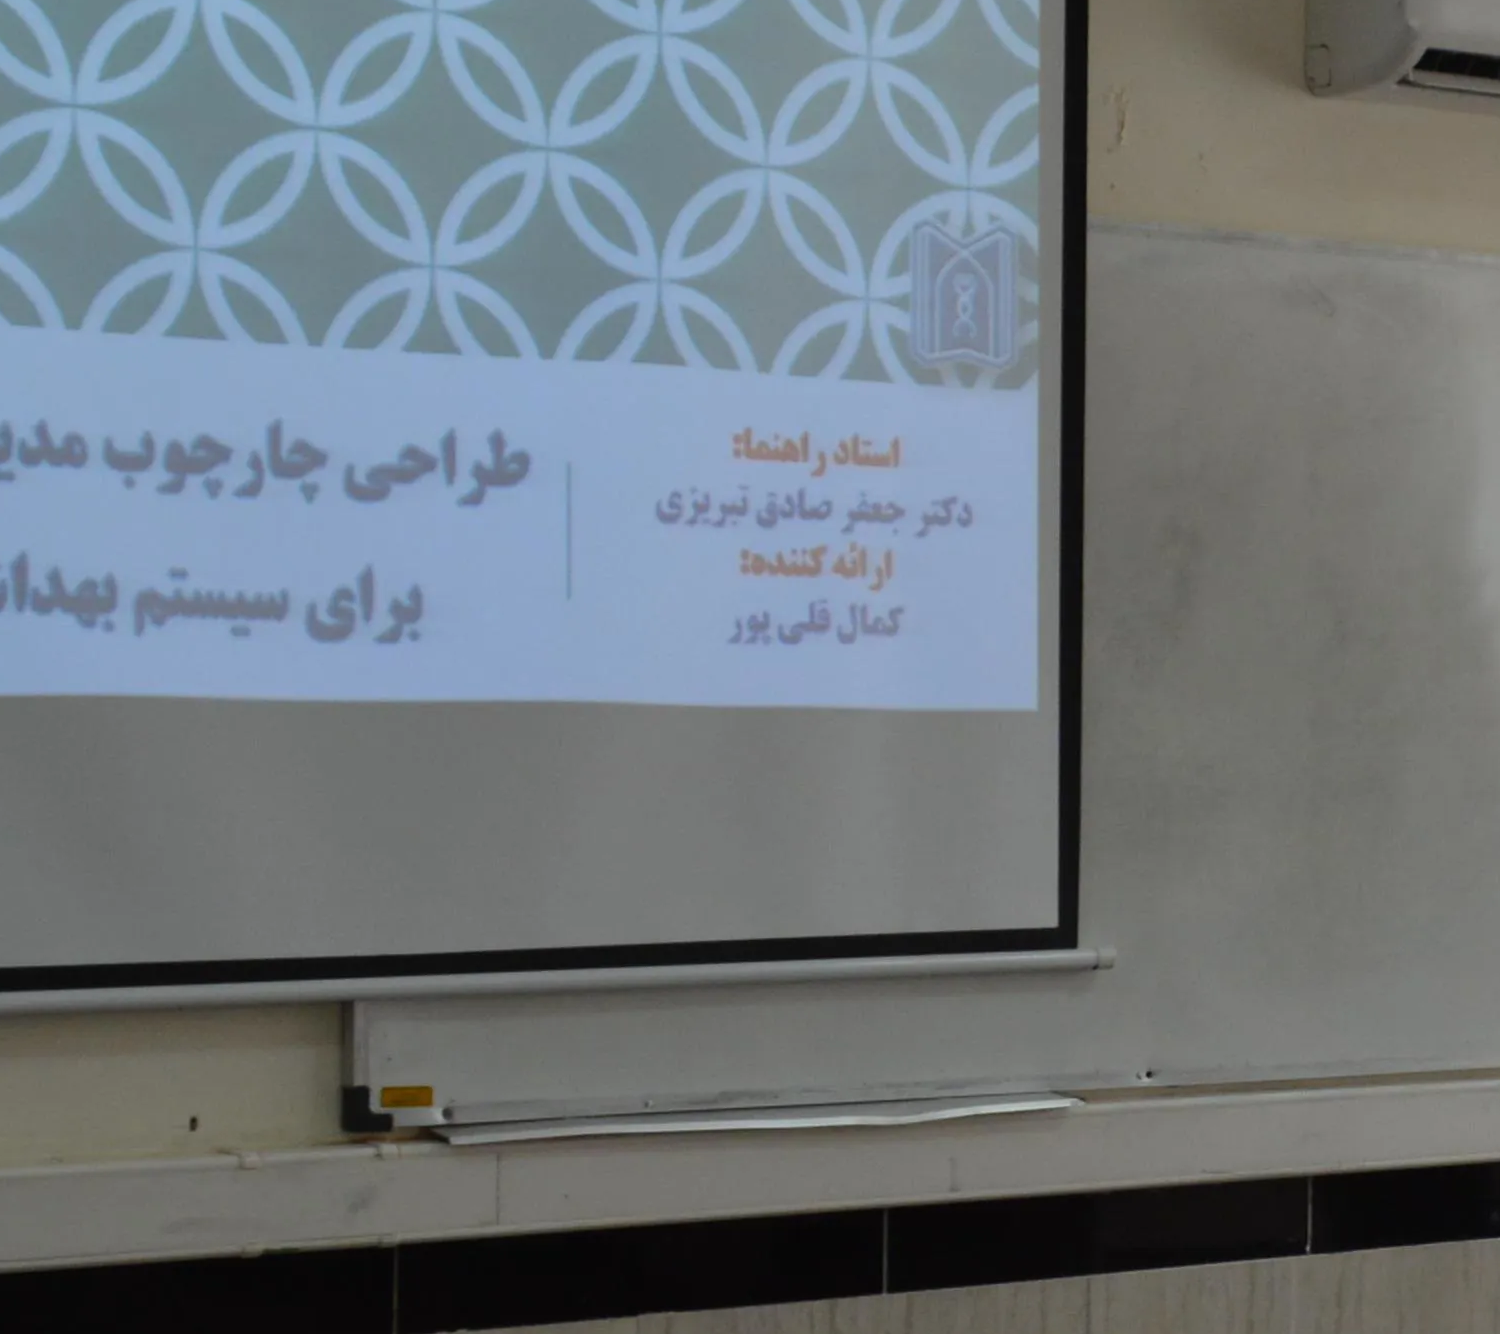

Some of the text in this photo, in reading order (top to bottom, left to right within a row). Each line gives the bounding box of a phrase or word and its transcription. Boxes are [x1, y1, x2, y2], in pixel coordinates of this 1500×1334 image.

[102, 420, 329, 503] چارچوب
[343, 429, 531, 505] طراحی
[833, 434, 901, 469] استاد
[655, 485, 975, 538] دکتر جعفر صادق تبریزی
[832, 543, 893, 591] ارائه
[133, 568, 290, 637] سیستم
[305, 567, 424, 644] برای
[727, 599, 904, 646] کمال قلی پور
